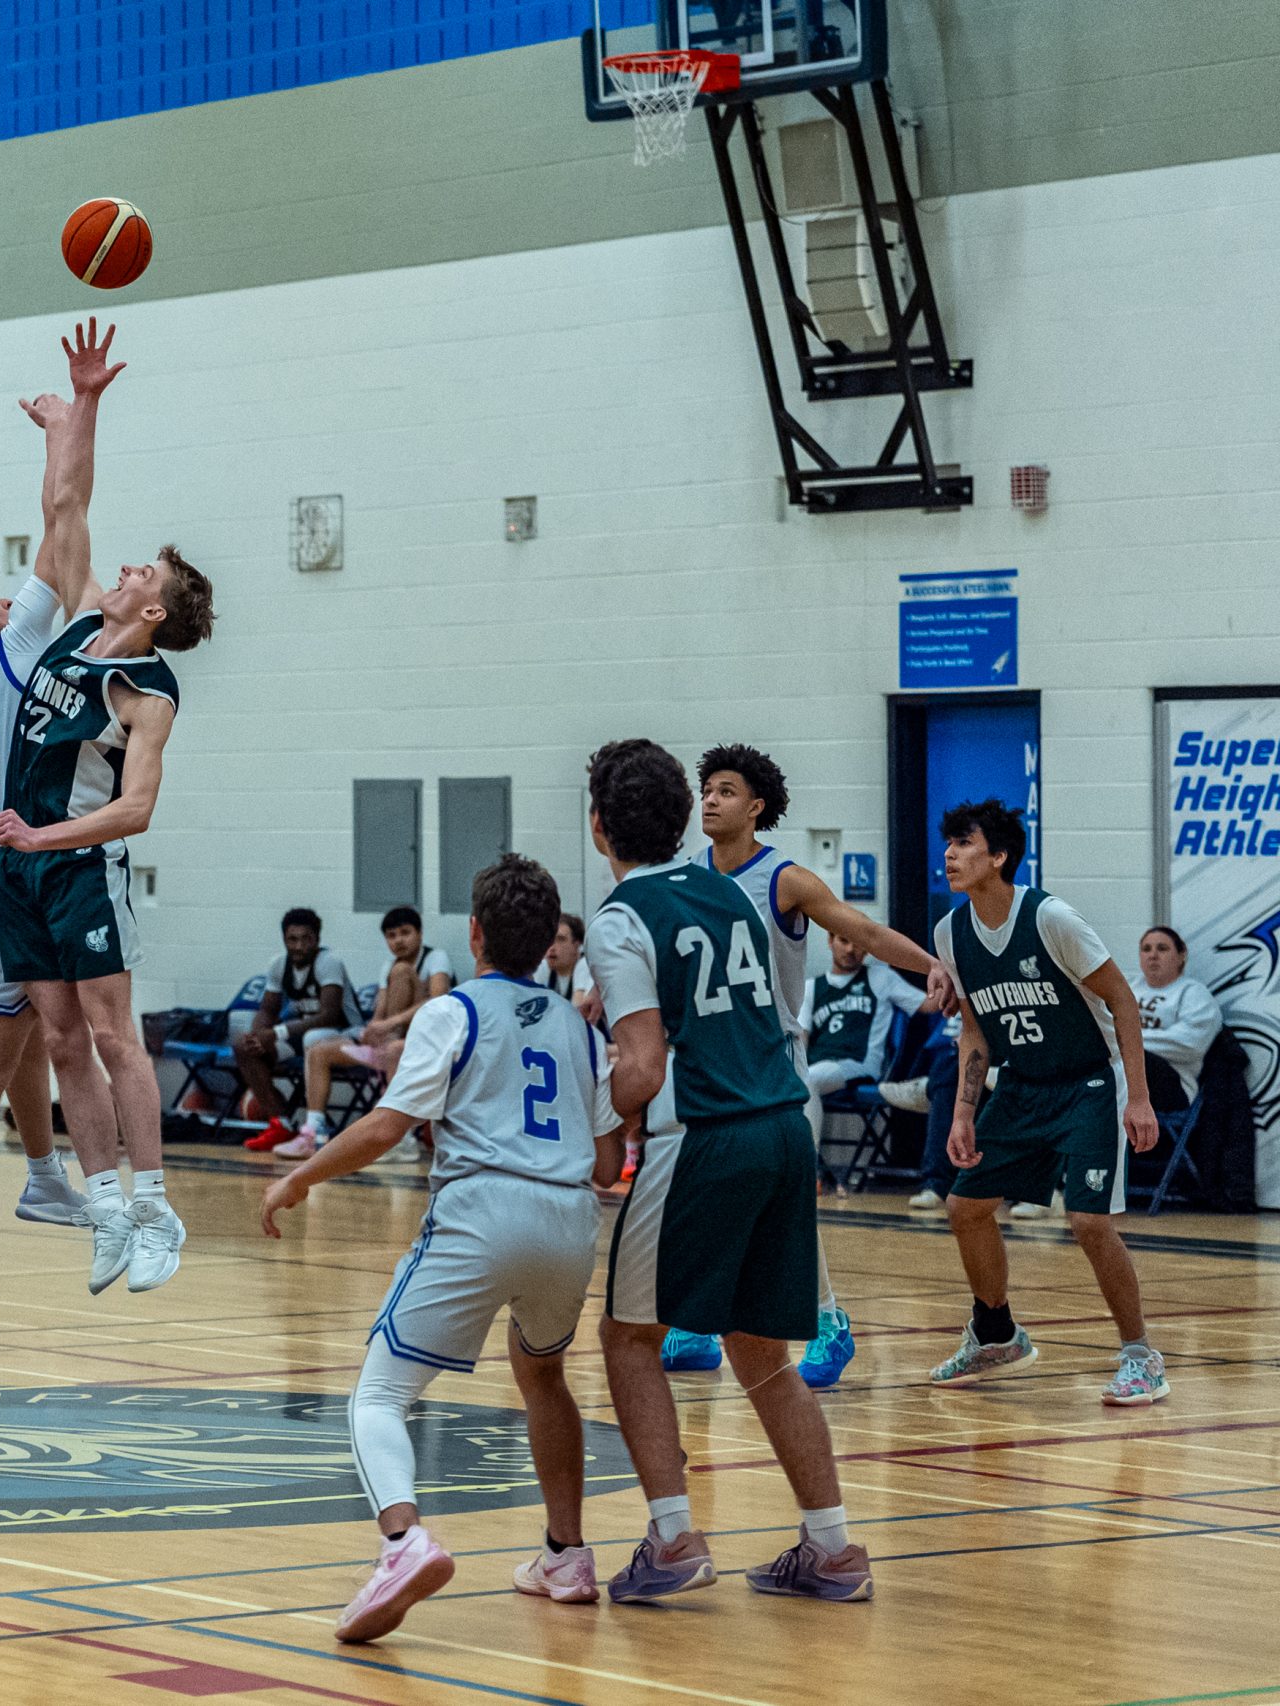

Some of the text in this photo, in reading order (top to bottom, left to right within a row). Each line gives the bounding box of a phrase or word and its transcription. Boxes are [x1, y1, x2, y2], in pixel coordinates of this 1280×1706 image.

[675, 920, 772, 1018] 24
[828, 1013, 844, 1035] 6
[1000, 1009, 1044, 1046] 25
[521, 1046, 561, 1142] 2
